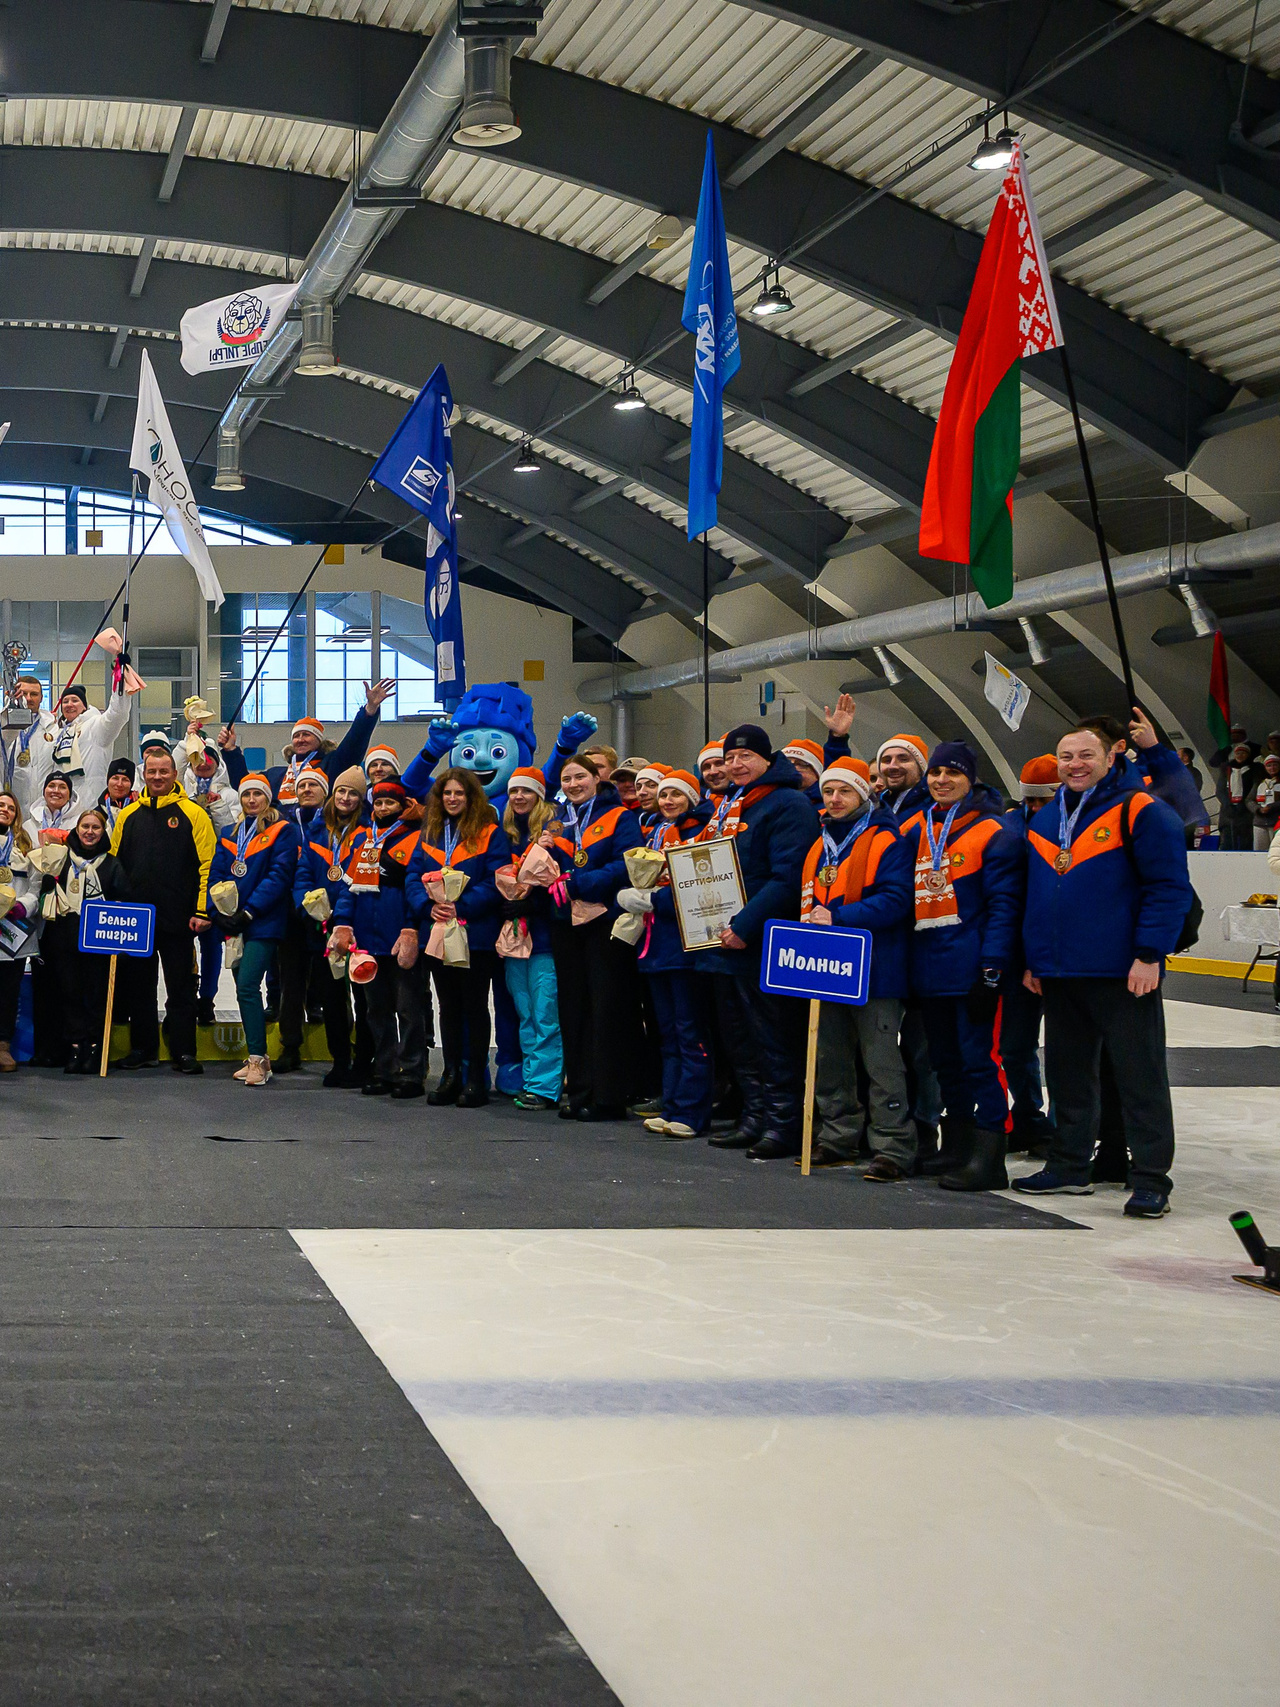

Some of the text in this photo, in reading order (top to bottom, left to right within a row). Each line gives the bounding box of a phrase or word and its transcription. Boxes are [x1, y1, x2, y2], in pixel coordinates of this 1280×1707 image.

[678, 872, 734, 889] СЕРТИФИКАТ
[98, 911, 138, 927] Белые
[95, 929, 138, 944] тигры
[778, 948, 853, 977] Молния
